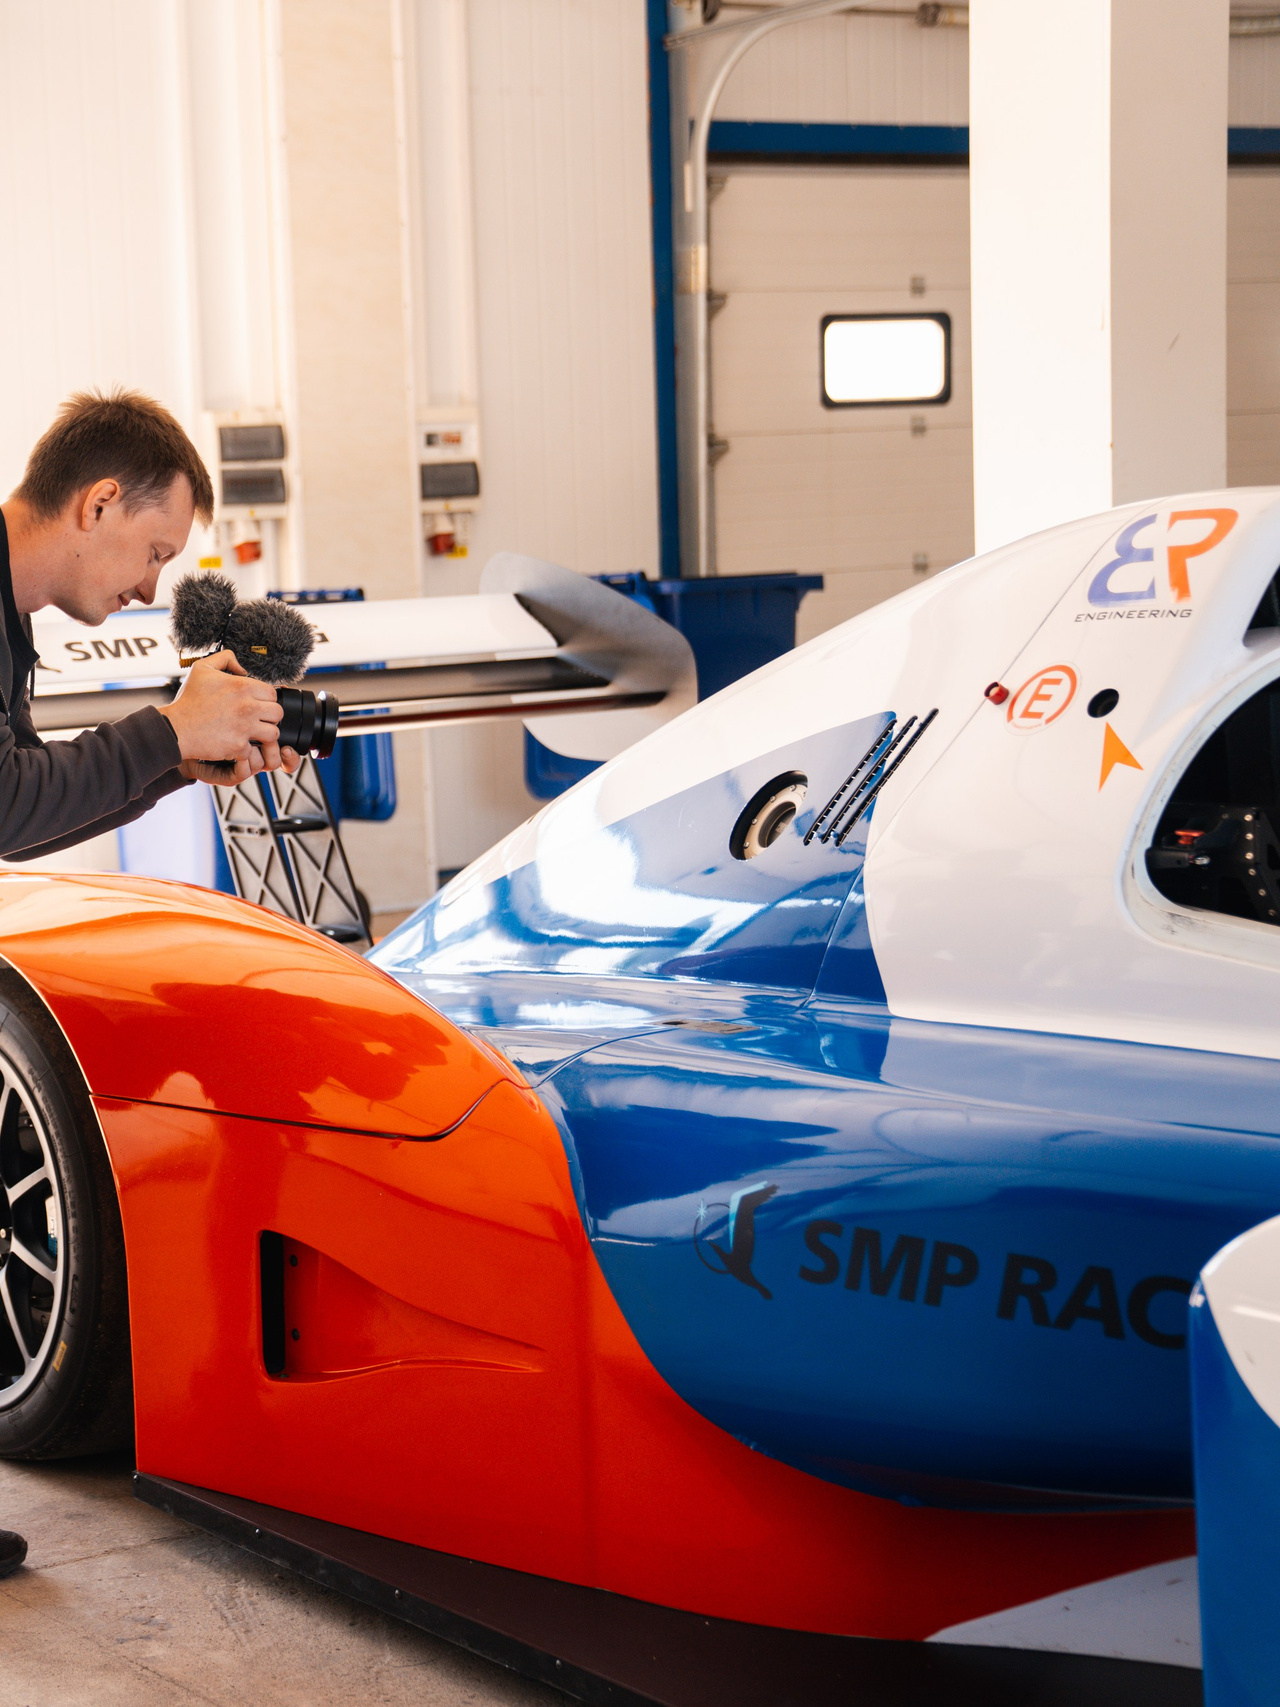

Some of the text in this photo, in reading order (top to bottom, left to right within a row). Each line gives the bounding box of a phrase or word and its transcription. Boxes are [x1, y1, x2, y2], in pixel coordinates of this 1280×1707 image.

[1075, 608, 1193, 623] ENGINEERING
[64, 637, 158, 661] SMP
[1019, 678, 1063, 719] E
[798, 1220, 979, 1306] SMP
